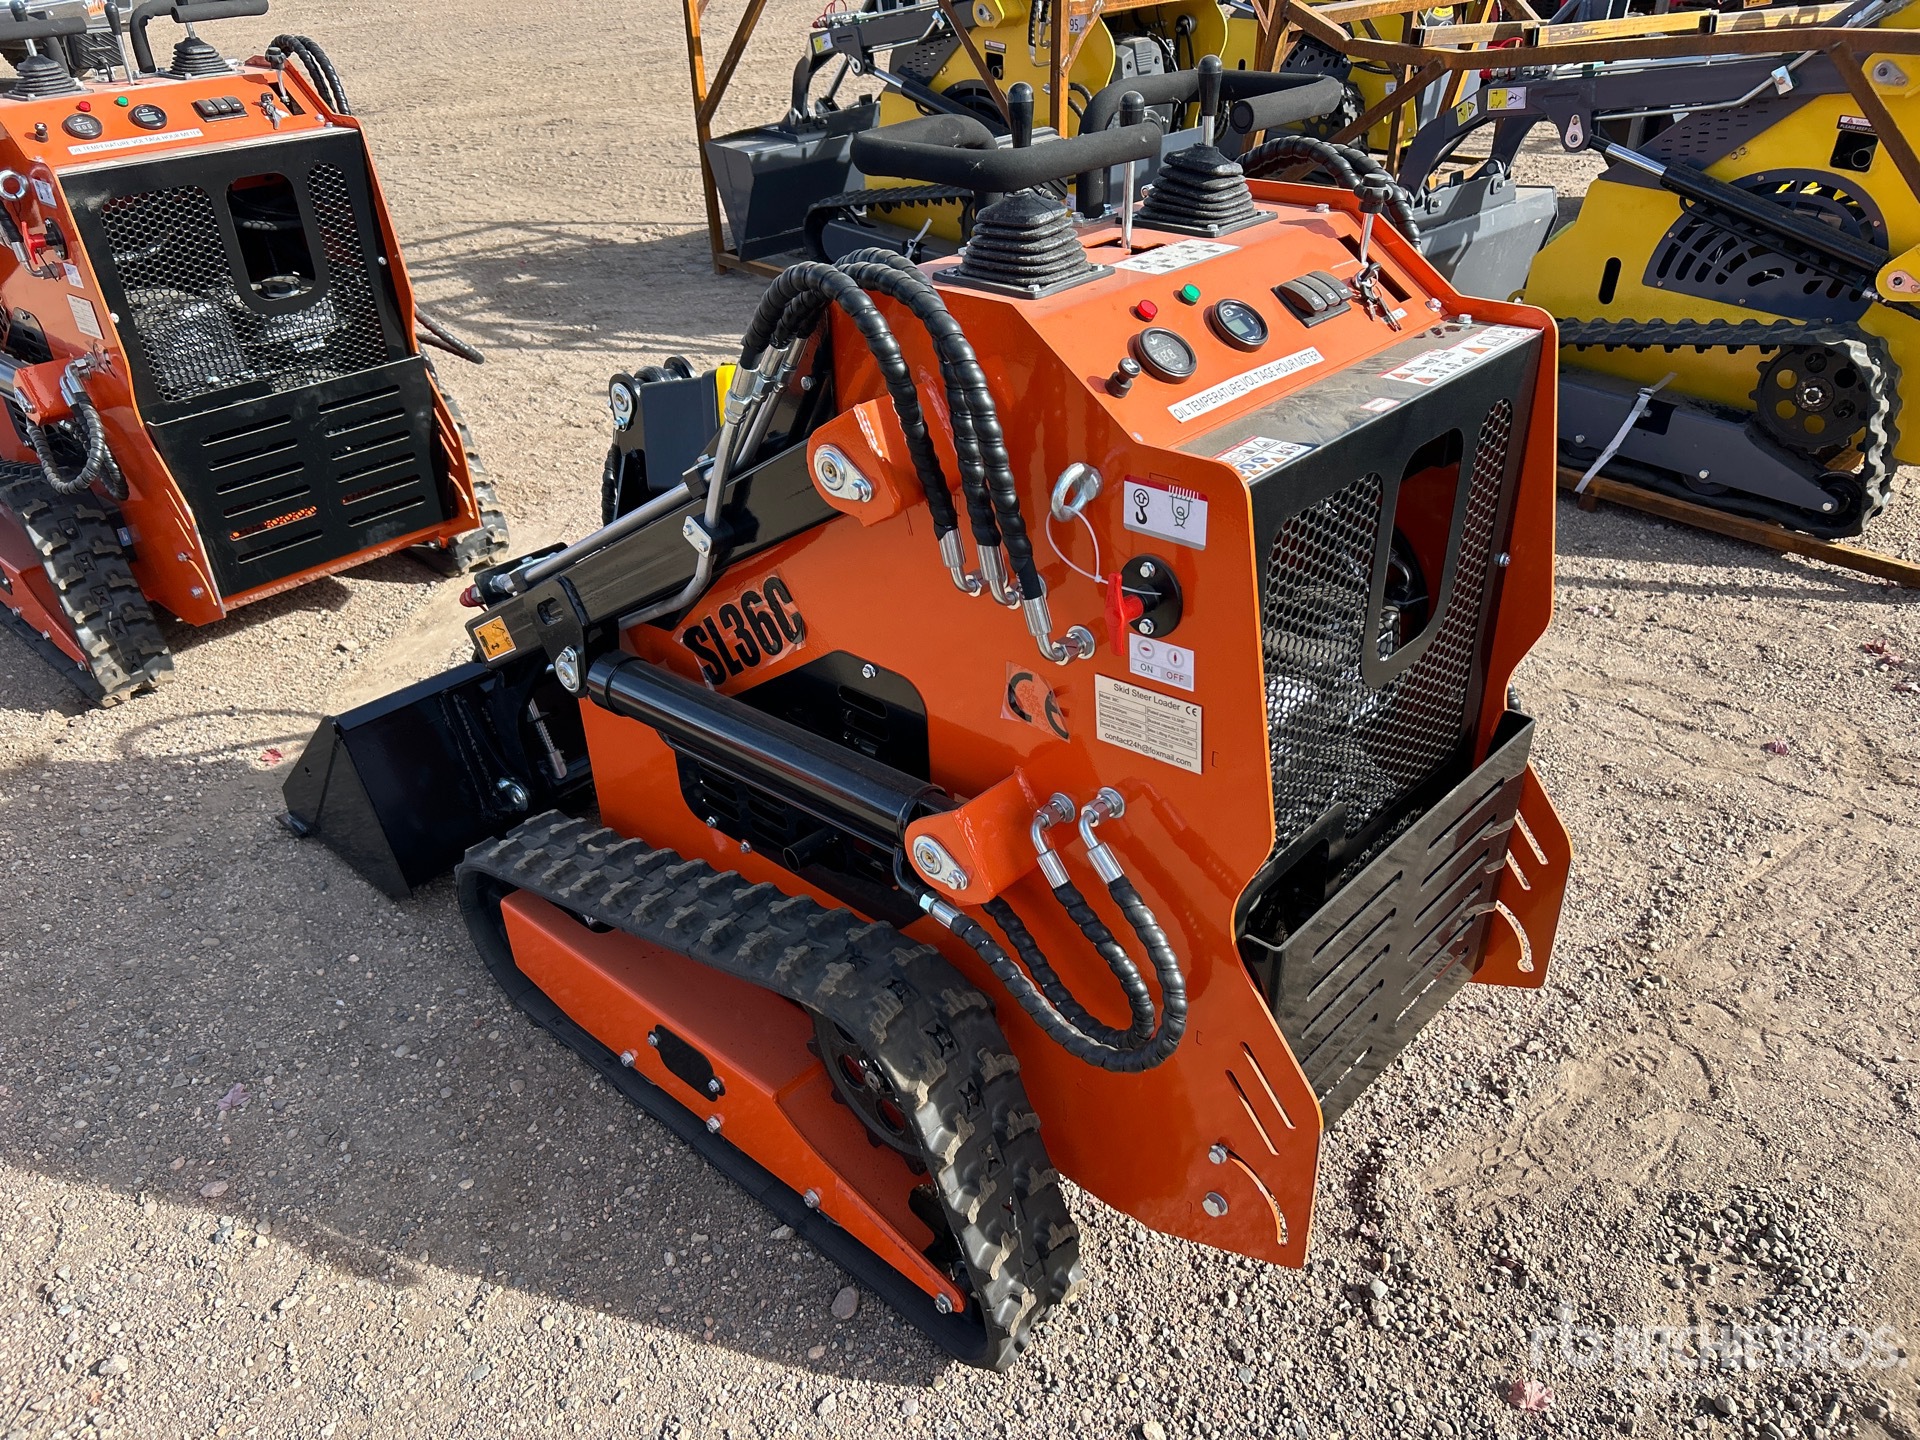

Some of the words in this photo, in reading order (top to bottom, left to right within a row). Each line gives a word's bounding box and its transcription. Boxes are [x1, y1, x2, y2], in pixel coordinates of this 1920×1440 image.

[1173, 401, 1192, 420] OIL
[1275, 358, 1297, 376] HOUR
[1297, 349, 1322, 368] METER
[682, 576, 805, 686] SL36C
[1140, 663, 1154, 674] ON
[1166, 671, 1185, 683] OFF
[1113, 683, 1131, 696] Skid
[1131, 688, 1153, 703] Steer
[1153, 695, 1182, 712] Loader
[1105, 732, 1192, 767] contact24h@foxmail.com
